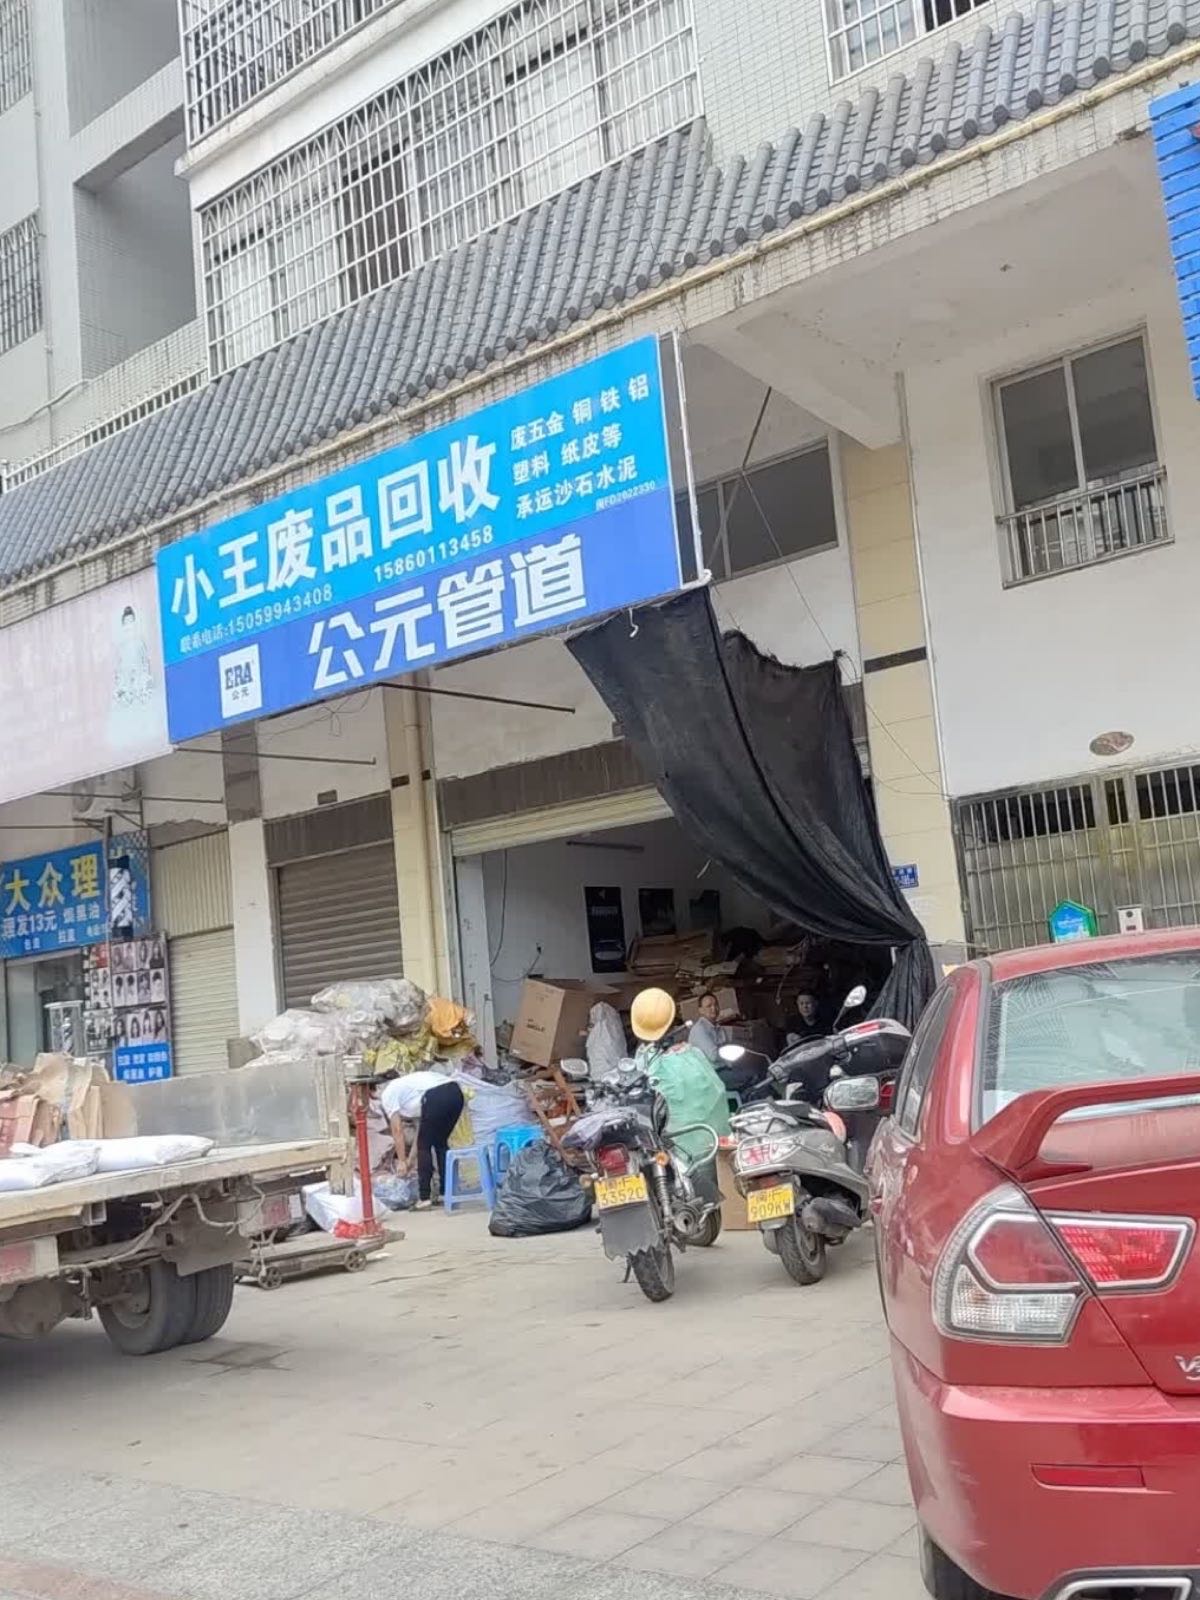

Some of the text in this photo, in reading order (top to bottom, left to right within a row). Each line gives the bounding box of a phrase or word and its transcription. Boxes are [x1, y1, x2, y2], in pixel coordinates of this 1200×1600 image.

[510, 373, 650, 451] 废五金 铜 铁 铝
[511, 422, 623, 486] 塑料 纸皮等
[516, 455, 639, 519] 承运沙石水泥
[170, 434, 499, 626] 小王废品回收
[374, 525, 494, 583] 15860113458
[308, 532, 587, 690] 公元管道
[224, 661, 254, 691] ERA
